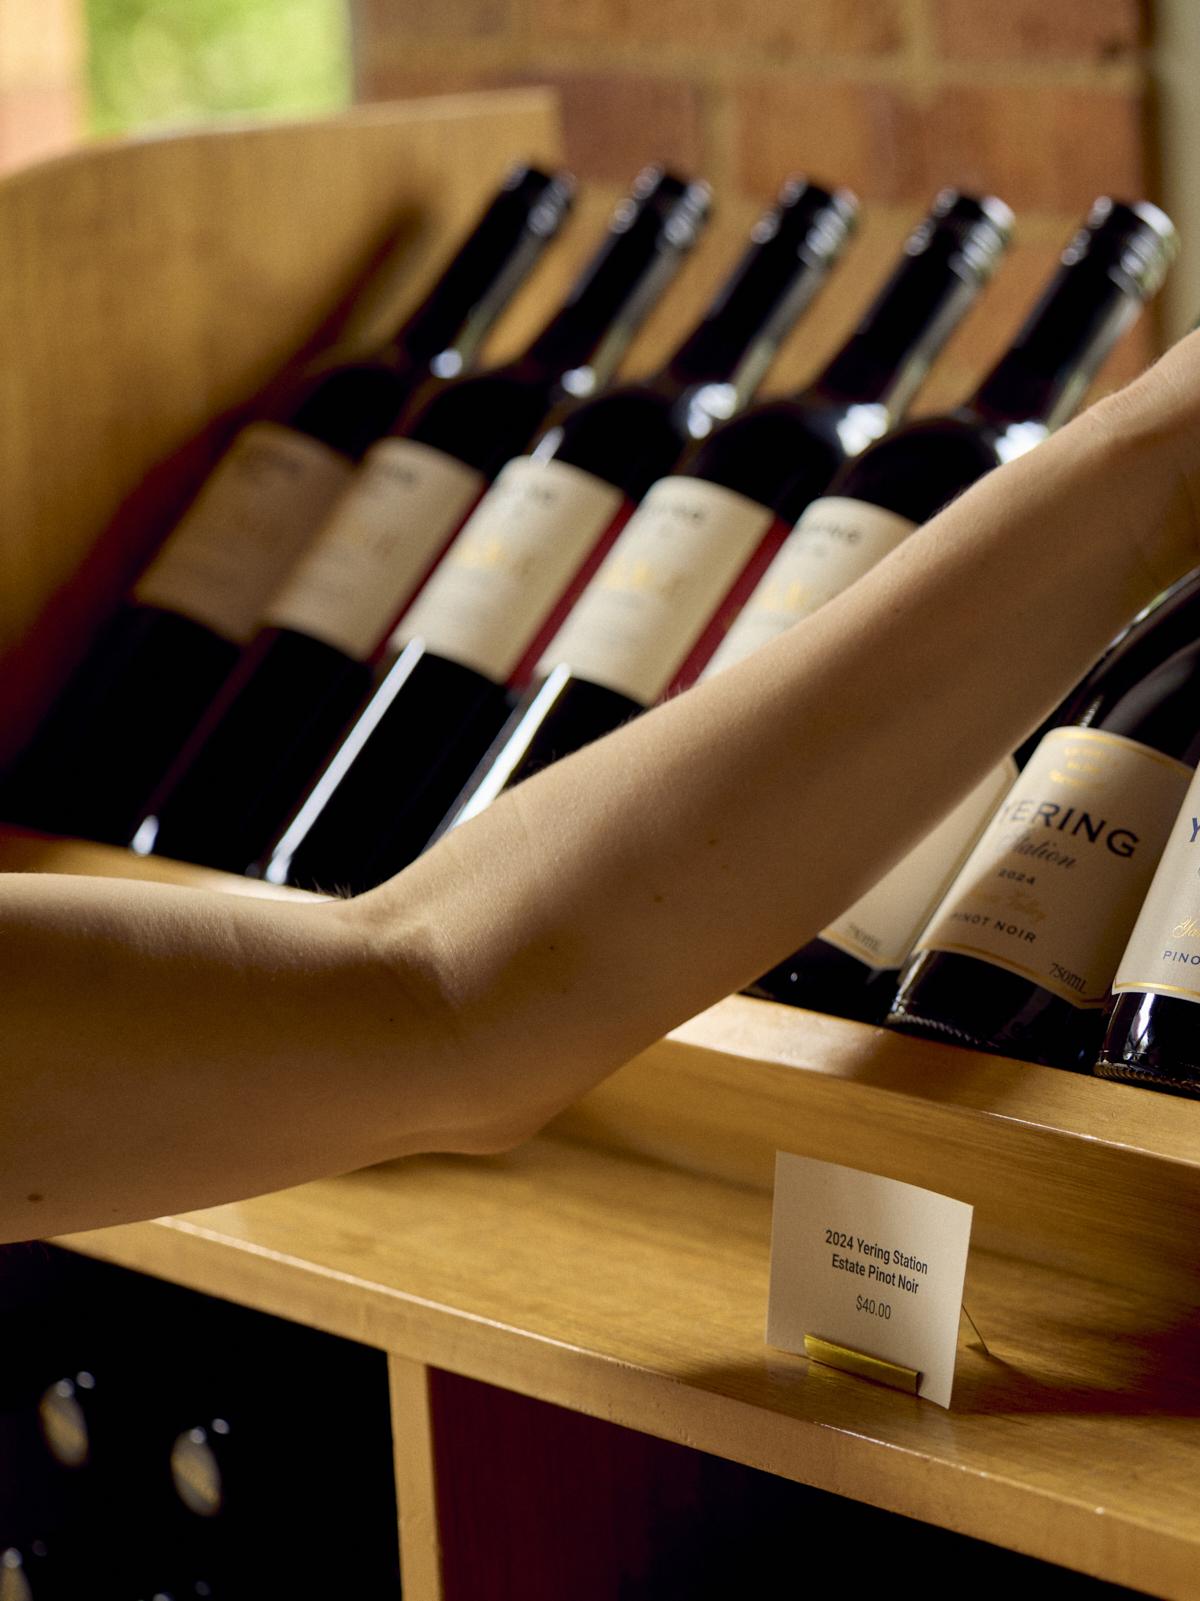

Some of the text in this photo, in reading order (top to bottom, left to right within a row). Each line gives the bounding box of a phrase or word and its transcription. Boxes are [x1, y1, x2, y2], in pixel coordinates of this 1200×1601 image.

[994, 920, 1037, 943] NOIR
[825, 1229, 929, 1275] 2024 Yering Station
[831, 1253, 919, 1294] Estate Pinot Noir
[856, 1294, 892, 1321] $40.00
